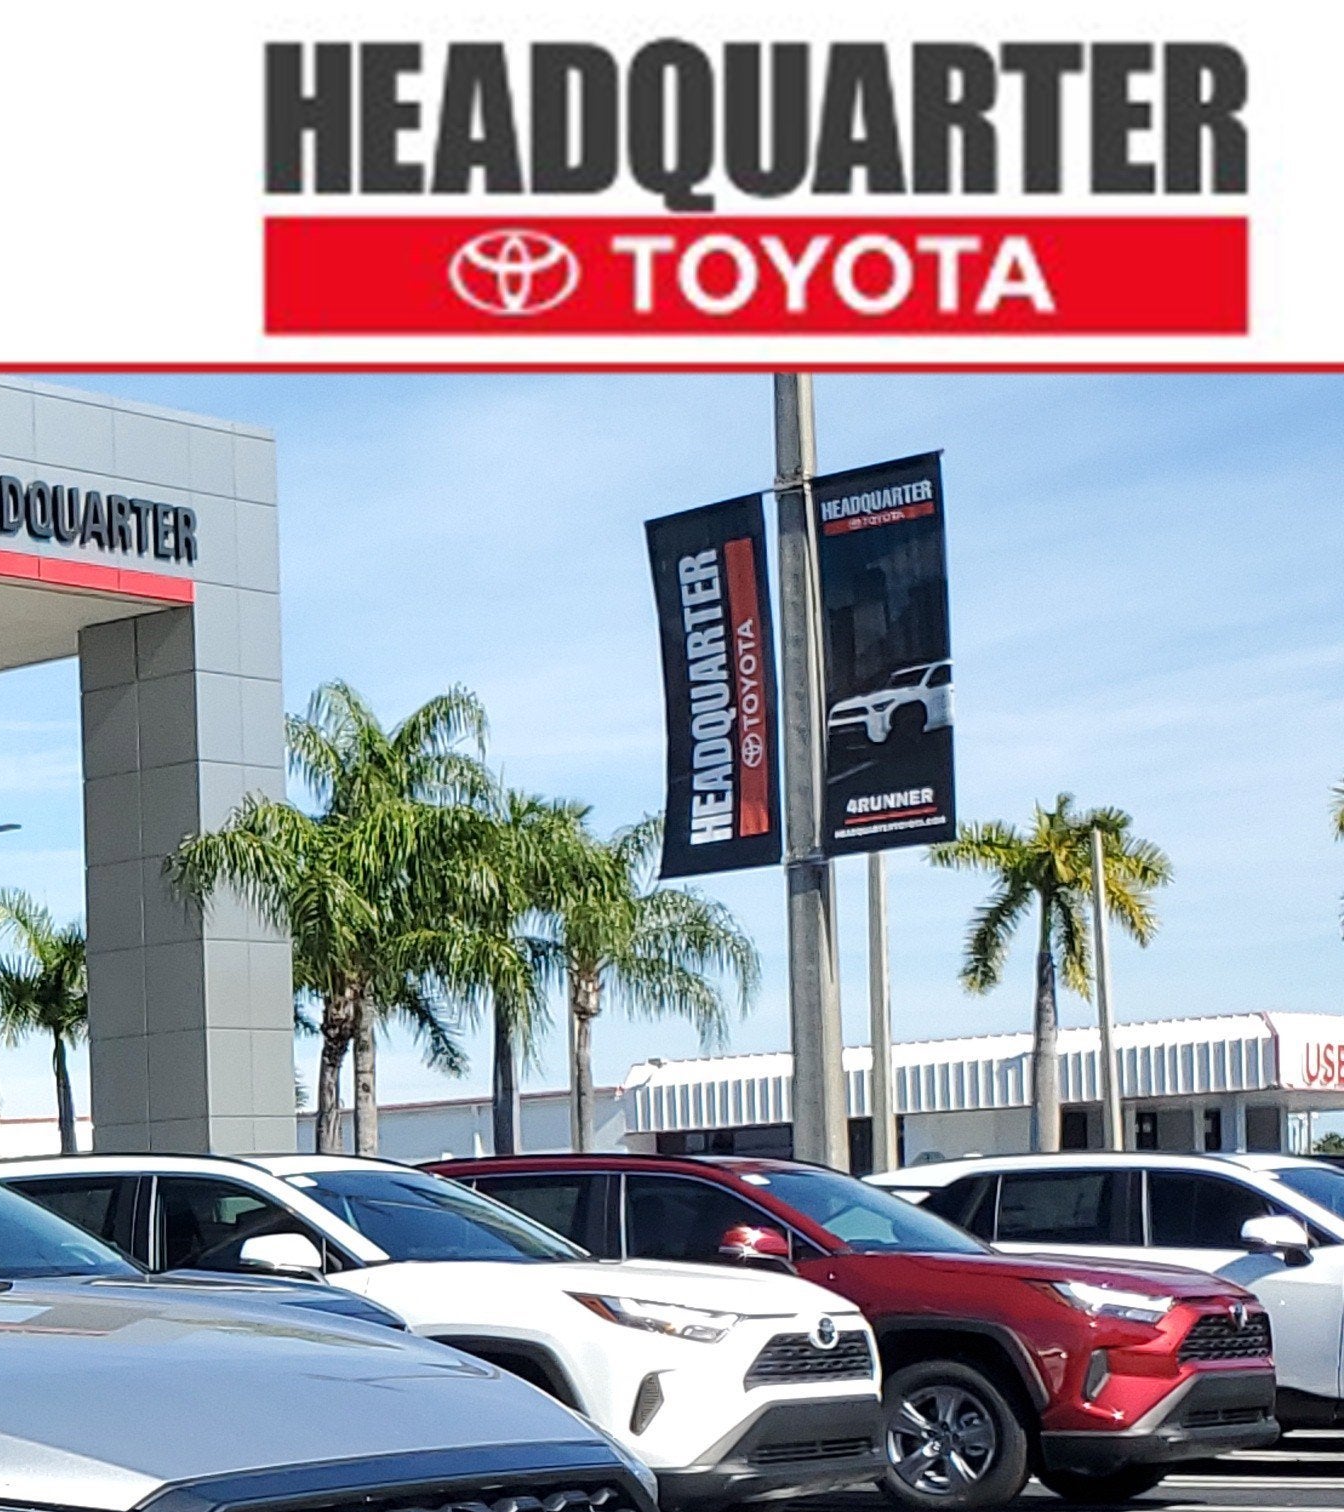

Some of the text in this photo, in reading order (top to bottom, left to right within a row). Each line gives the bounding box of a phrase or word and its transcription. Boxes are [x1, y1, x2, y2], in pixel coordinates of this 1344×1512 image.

[820, 479, 933, 521] HEADQUARTER
[863, 511, 905, 526] TOYOTA
[736, 618, 760, 730] TOYOTA
[678, 548, 737, 845] HEADQUARTER
[846, 787, 934, 814] 4RUNNER
